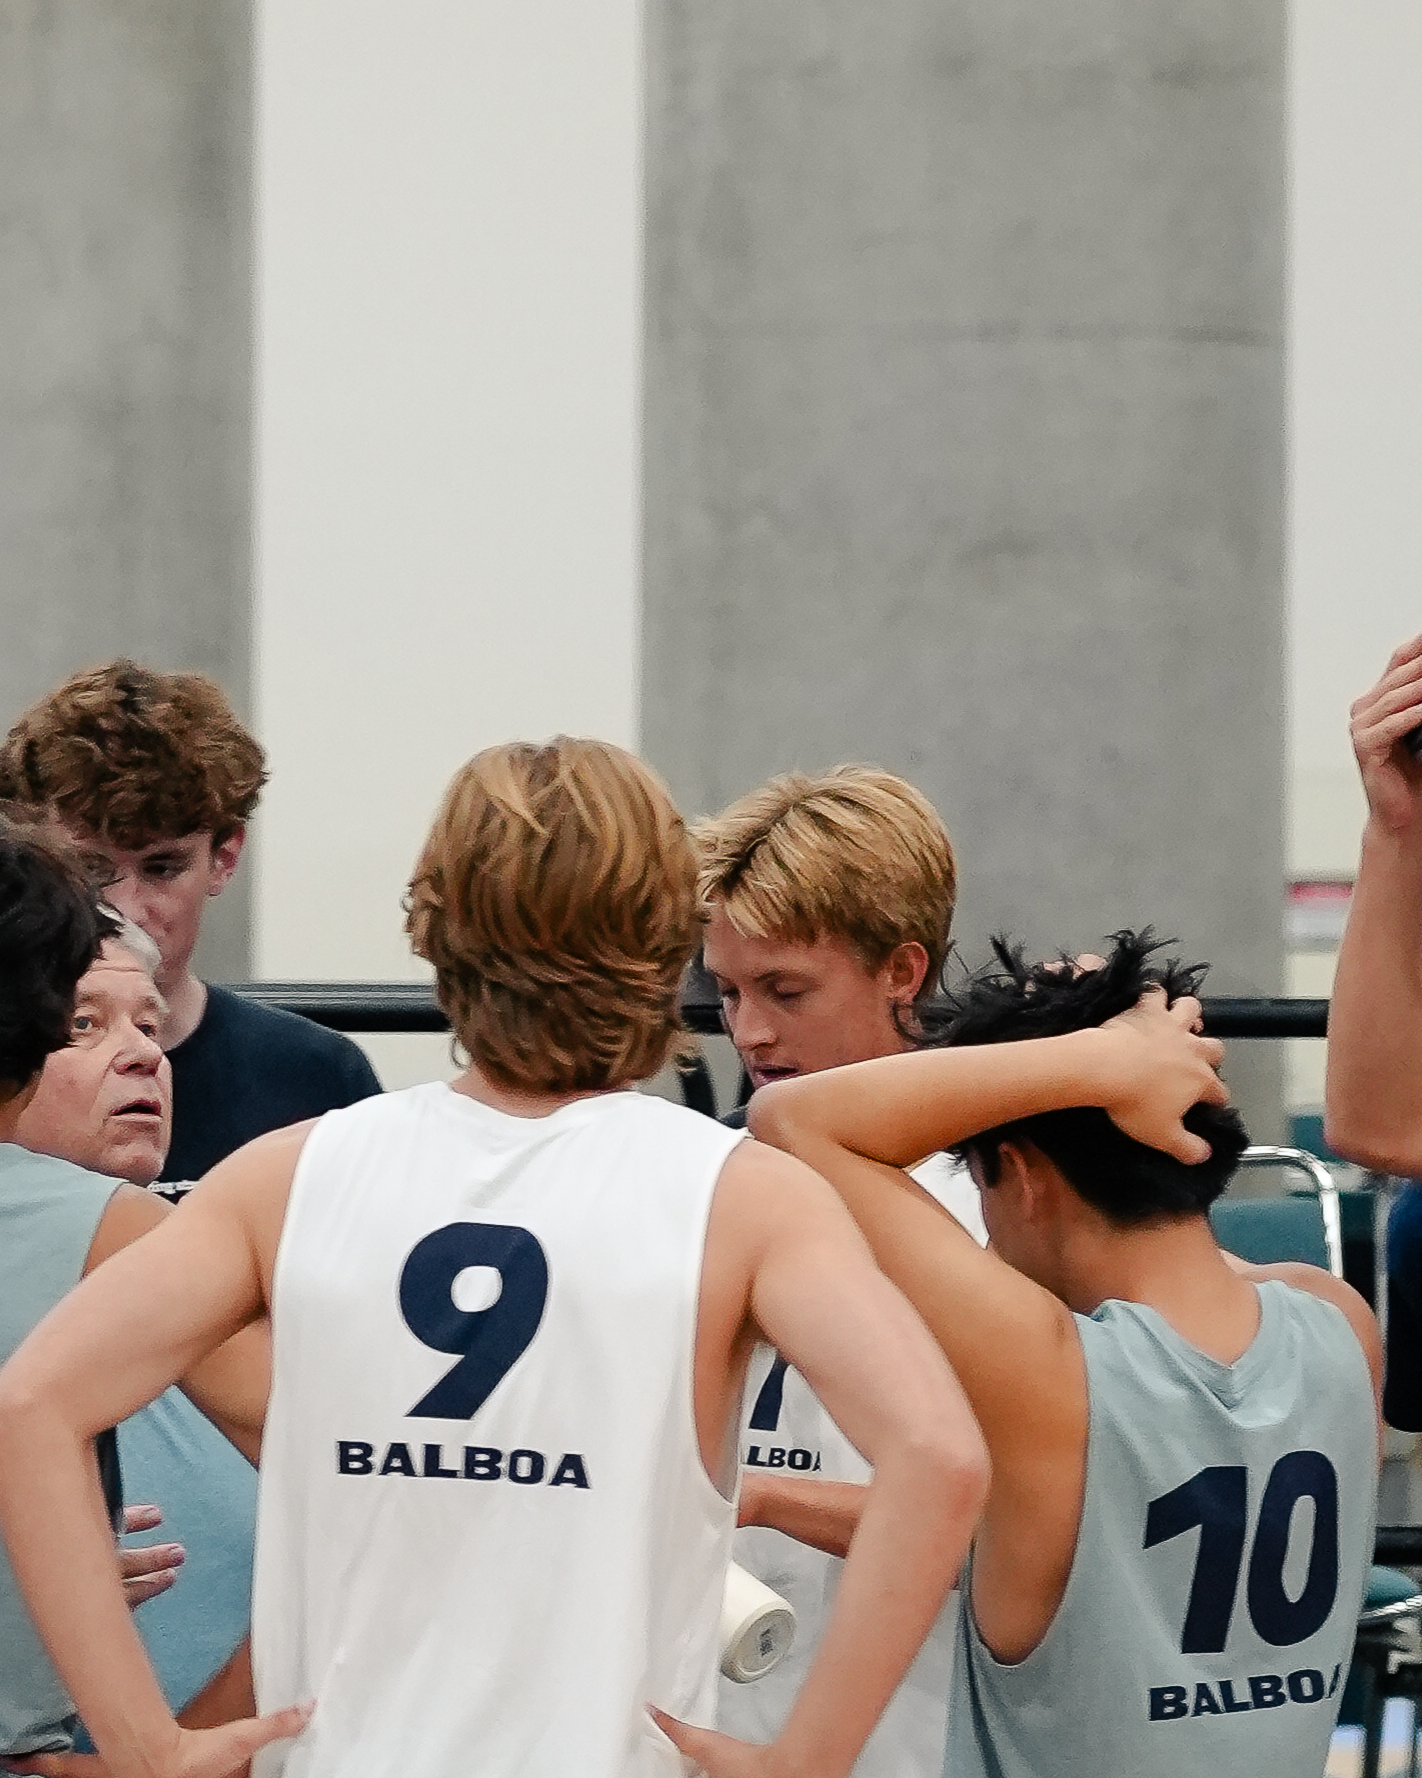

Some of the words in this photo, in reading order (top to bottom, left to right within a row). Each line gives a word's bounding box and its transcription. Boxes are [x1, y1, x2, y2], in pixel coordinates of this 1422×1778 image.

[398, 1220, 550, 1422] 9
[335, 1439, 592, 1490] BALBOA
[1140, 1449, 1340, 1656] 10
